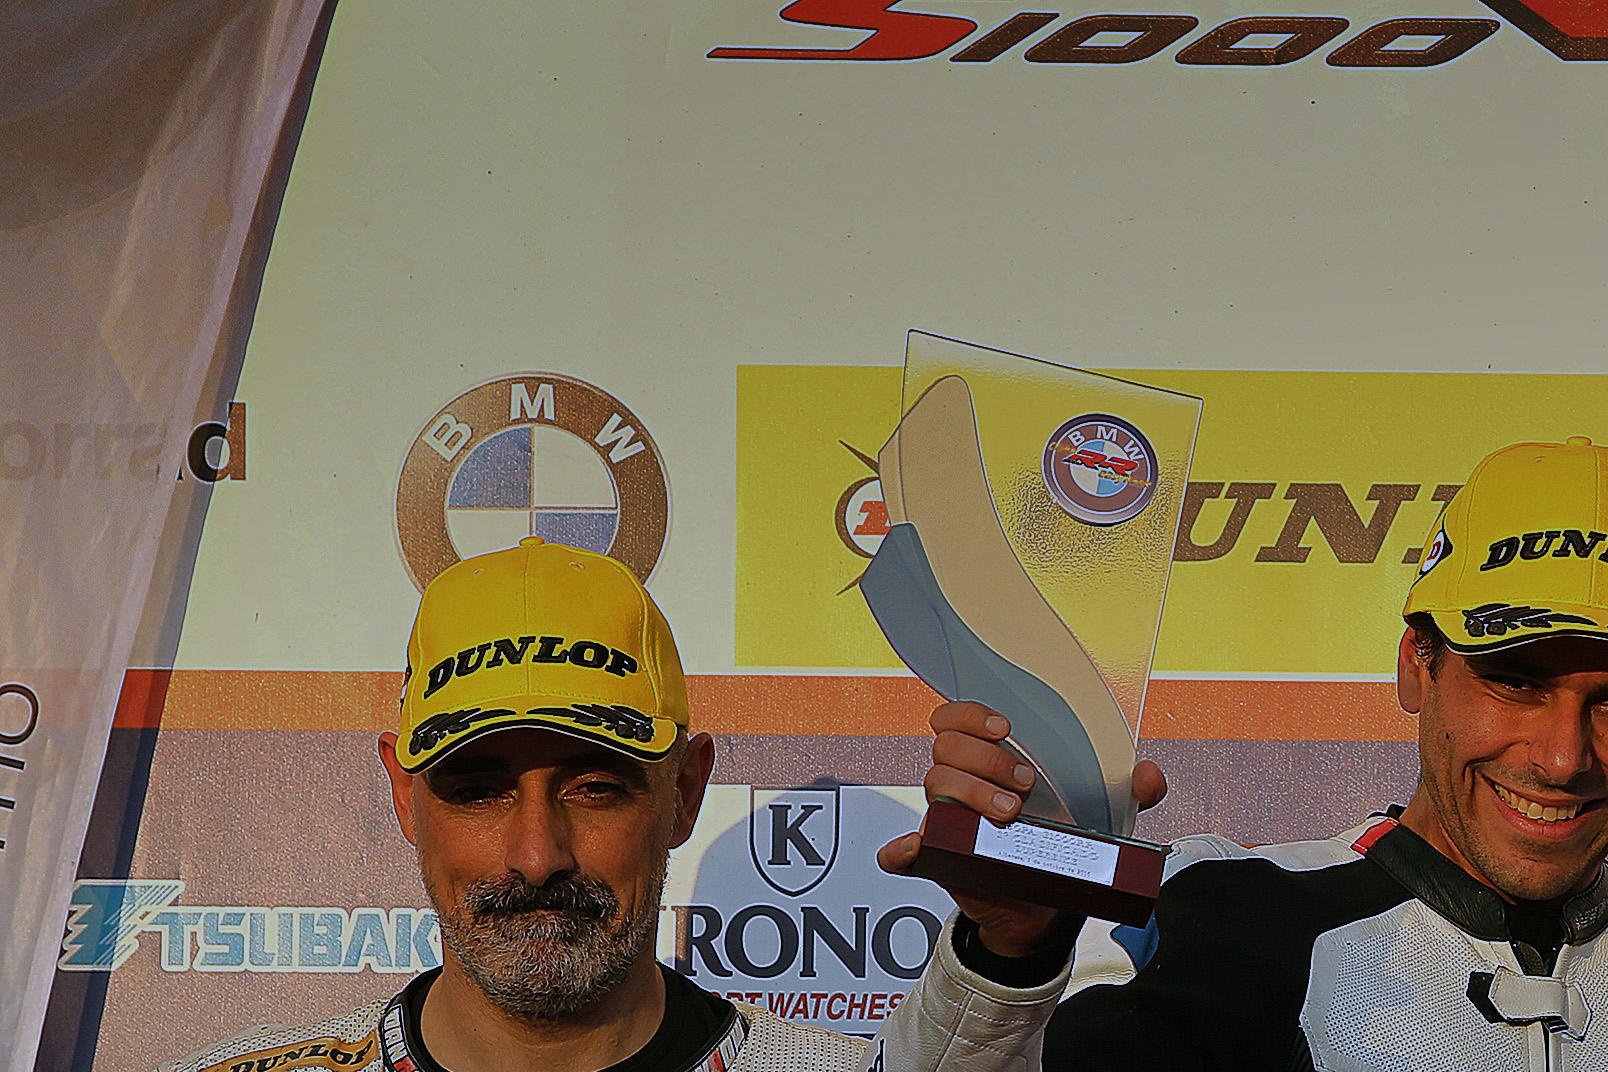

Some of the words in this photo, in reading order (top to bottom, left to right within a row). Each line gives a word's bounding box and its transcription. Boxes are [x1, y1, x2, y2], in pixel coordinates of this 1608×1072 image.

[422, 383, 646, 464] BMW
[1067, 425, 1145, 461] BMW
[423, 636, 638, 699] DUNLOP
[153, 912, 441, 967] TSUBAK
